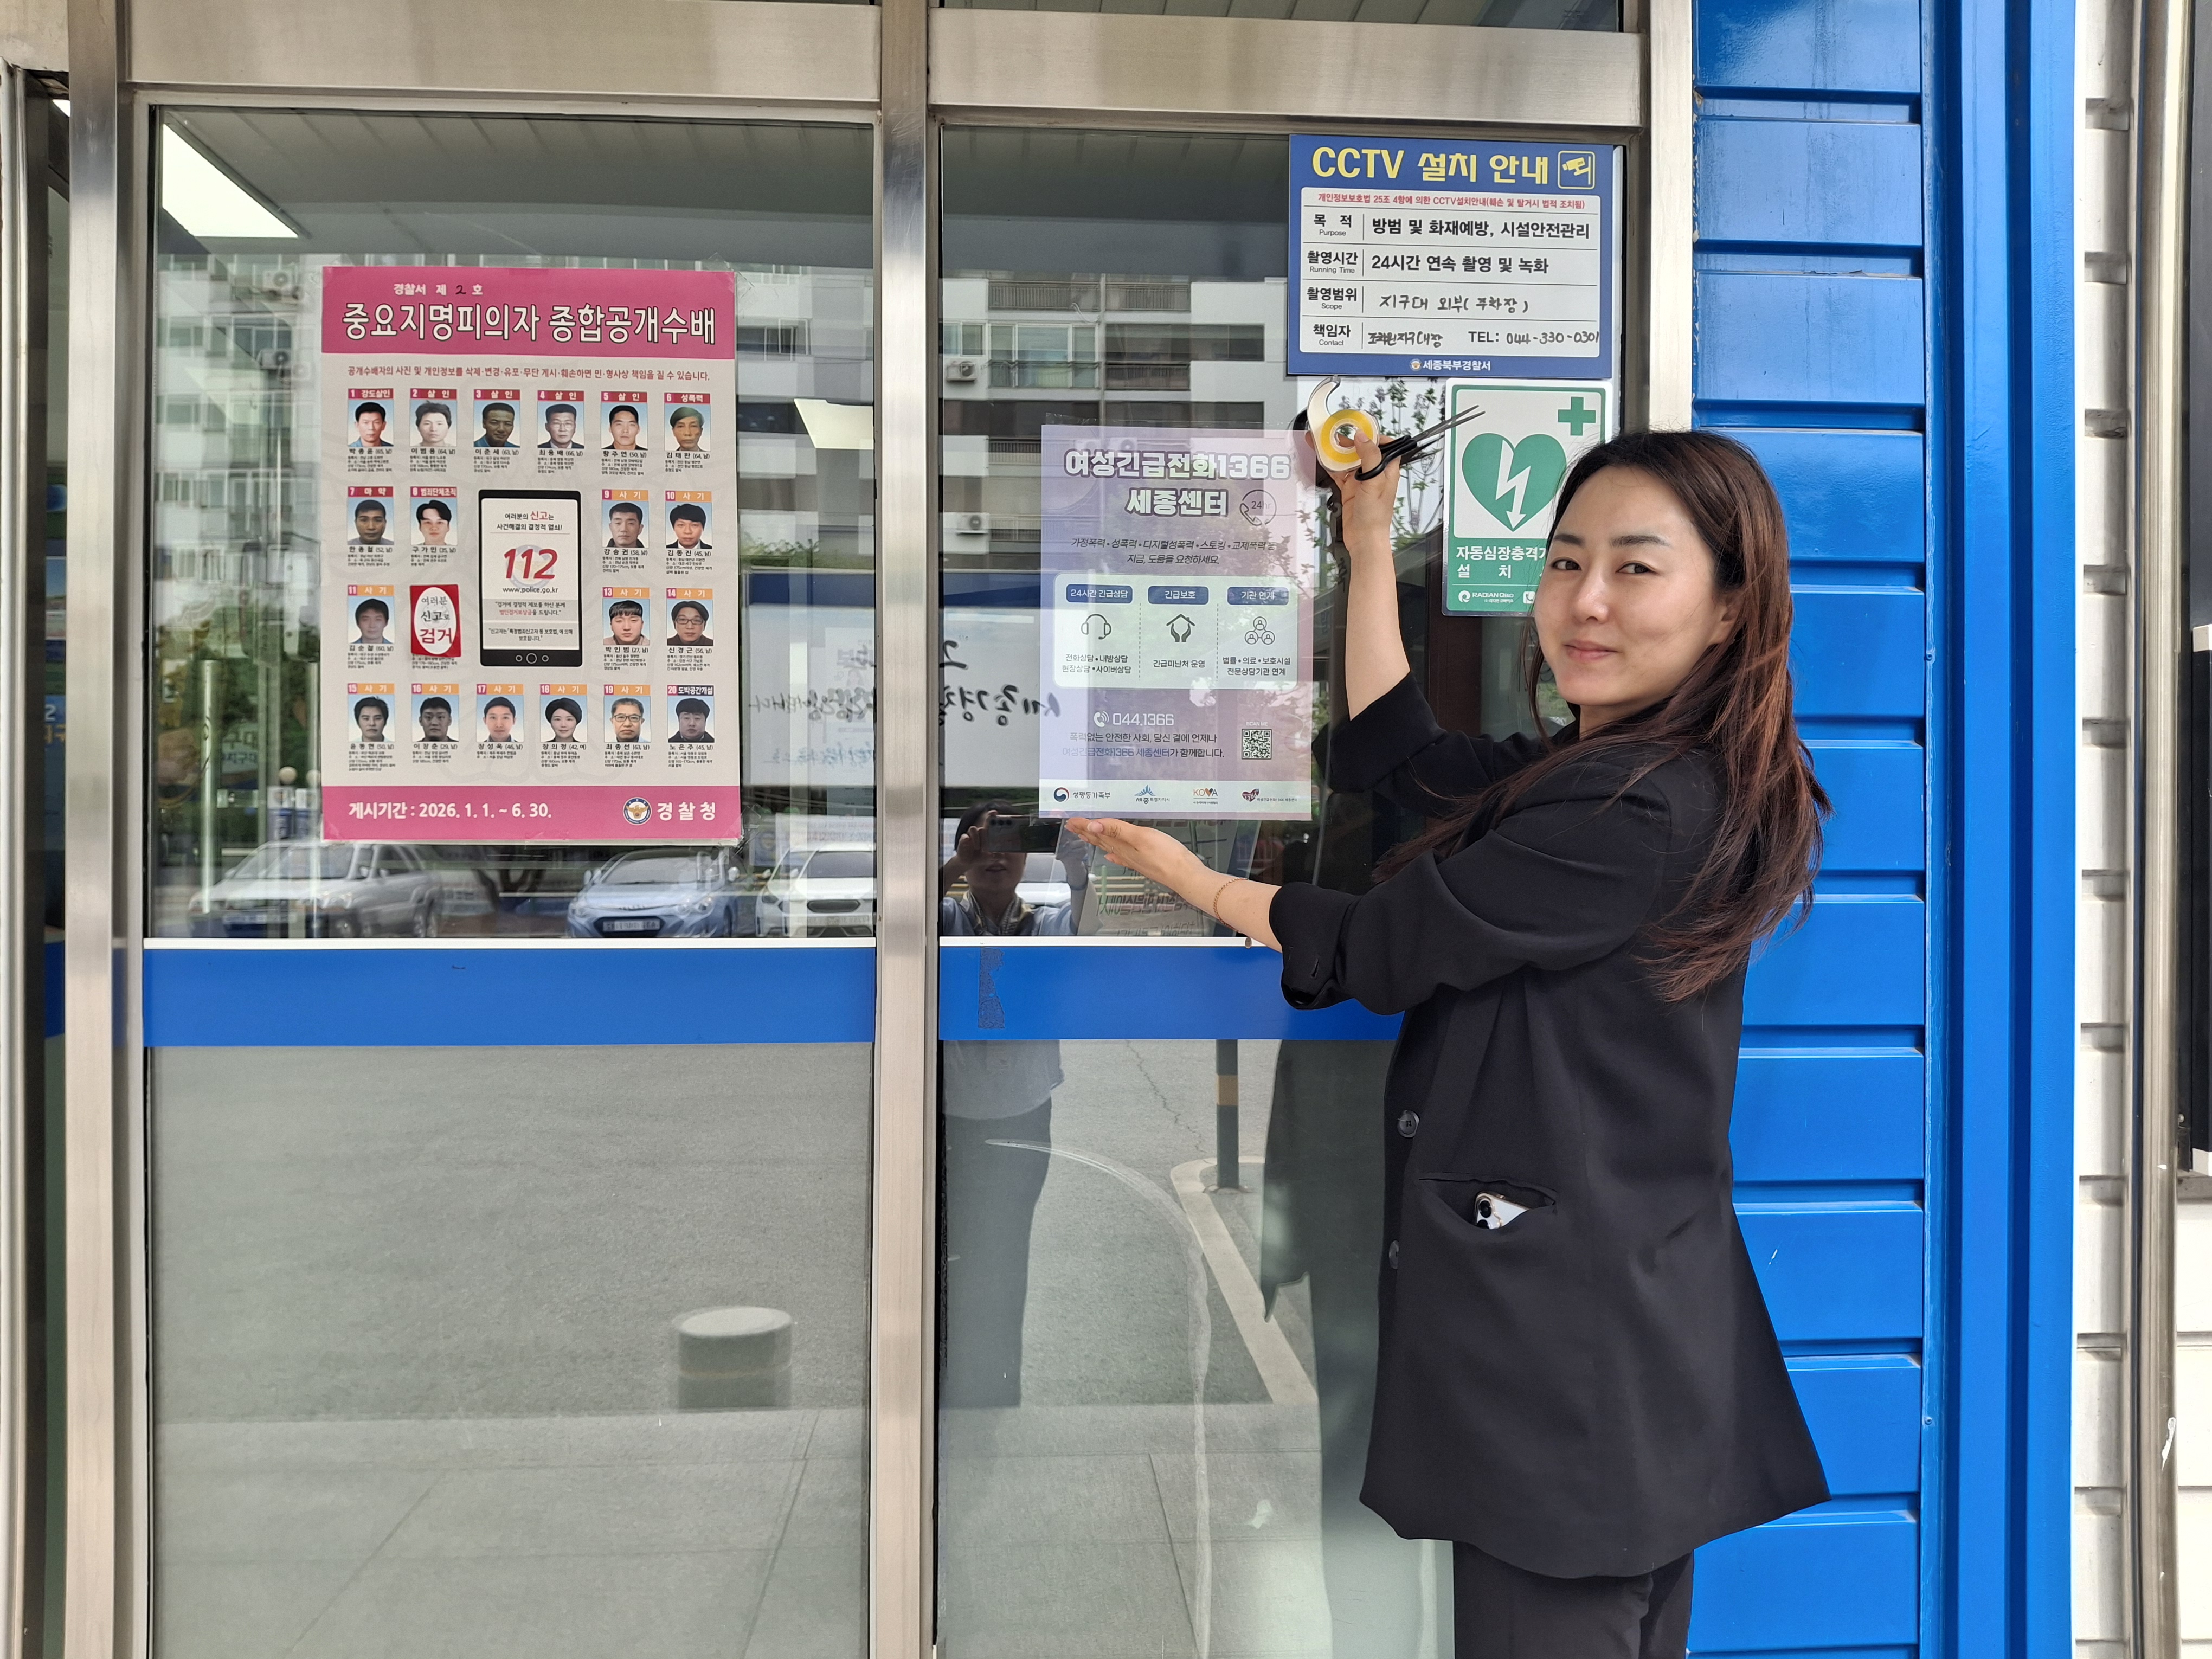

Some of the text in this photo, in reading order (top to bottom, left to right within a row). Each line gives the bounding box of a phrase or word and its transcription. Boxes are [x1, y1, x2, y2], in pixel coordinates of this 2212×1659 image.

[1313, 147, 1548, 184] CCTV 설치 안내
[1318, 193, 1371, 203] 개인정보보호법
[1373, 195, 1390, 203] 25조
[1393, 196, 1413, 204] 4항에
[1416, 196, 1430, 205] 의한
[1507, 198, 1514, 207] 및
[1517, 199, 1539, 208] 탈거시
[1542, 200, 1557, 208] 법적
[1559, 200, 1585, 209] 조치됨)
[1372, 218, 1590, 239] 방범 및 화재예방, 시설안전관리
[1307, 250, 1358, 265] 촬영시간
[1372, 255, 1549, 274] 24시간 연속 촬영 및 녹화
[394, 283, 483, 296] 경찰서 제 2 호
[1307, 287, 1357, 301] 촬영범위
[1379, 294, 1429, 310] 지구대
[342, 303, 716, 345] 중요지명피의자 종합공개수배
[1313, 324, 1351, 338] 책임자
[1468, 331, 1499, 343] TEL:
[1506, 331, 1599, 344] 044-330-0301
[1423, 359, 1491, 371] 세종북부경찰서
[348, 366, 394, 376] 공개수배자의
[396, 365, 411, 375] 사진
[414, 366, 422, 376] 및
[424, 366, 463, 377] 개인정보를
[631, 370, 654, 380] 책임을
[657, 370, 664, 380] 질
[666, 371, 674, 380] 수
[677, 371, 710, 381] 있습니다.
[361, 390, 390, 398] 강도살인
[412, 390, 417, 398] 2
[666, 393, 703, 403] 6 성폭력
[1065, 449, 1291, 480] 여성긴급전화1366
[604, 491, 609, 499] 9
[666, 492, 675, 500] 10
[1126, 488, 1228, 516] 세종센터
[1251, 500, 1272, 510] 24hr
[530, 511, 555, 521] 신고는
[504, 548, 558, 580] 112
[1127, 554, 1219, 564] 지금, 도움을 요청하세요.
[502, 586, 558, 594] www.police.go.kr
[1071, 589, 1128, 599] 24시간 긴급상담
[1165, 590, 1195, 600] 긴급보호
[1242, 591, 1274, 600] 기관 연계
[421, 596, 448, 606] 여러분
[421, 610, 451, 622] 신고로
[420, 628, 452, 644] 검거
[1153, 659, 1205, 668] 긴급피난처 운영
[1227, 667, 1286, 676] 전문상담기관 연계
[541, 685, 550, 693] 18
[678, 686, 713, 696] 도박공간개설
[1113, 713, 1174, 726] 044.1366
[1070, 732, 1217, 743] 폭력없는 안전한 사회, 당신 곁에 언제나
[1062, 747, 1225, 758] 여성긴급전화1366 세종센터가 함께합니다.
[348, 802, 408, 820] 게시기간
[419, 802, 461, 819] 2026.
[529, 803, 552, 819] 30.
